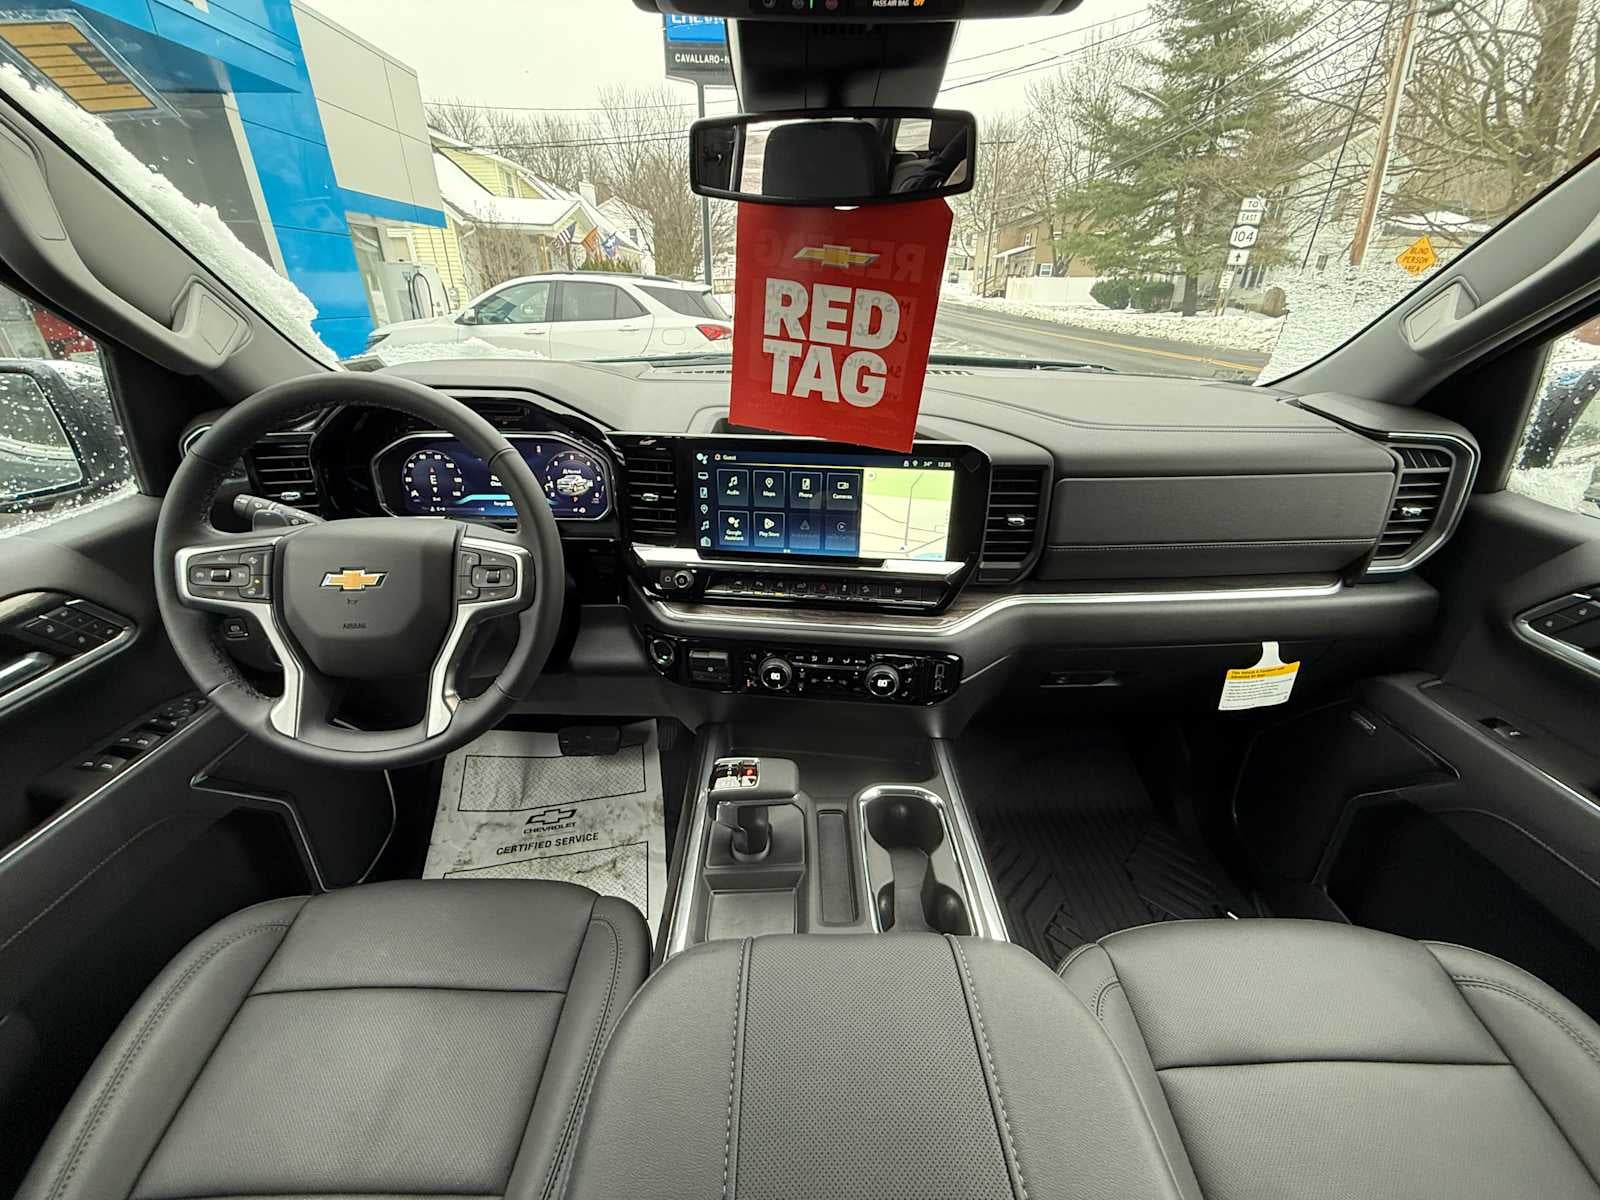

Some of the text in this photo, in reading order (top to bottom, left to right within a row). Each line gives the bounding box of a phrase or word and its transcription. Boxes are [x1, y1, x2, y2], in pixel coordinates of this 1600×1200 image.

[1248, 200, 1259, 208] TO
[1240, 213, 1258, 222] EAST
[1233, 231, 1255, 243] 104
[764, 278, 901, 350] RED
[762, 338, 889, 408] TAG
[523, 822, 576, 834] CHEVROLET
[496, 832, 599, 855] CERTIFIED SERVICE
